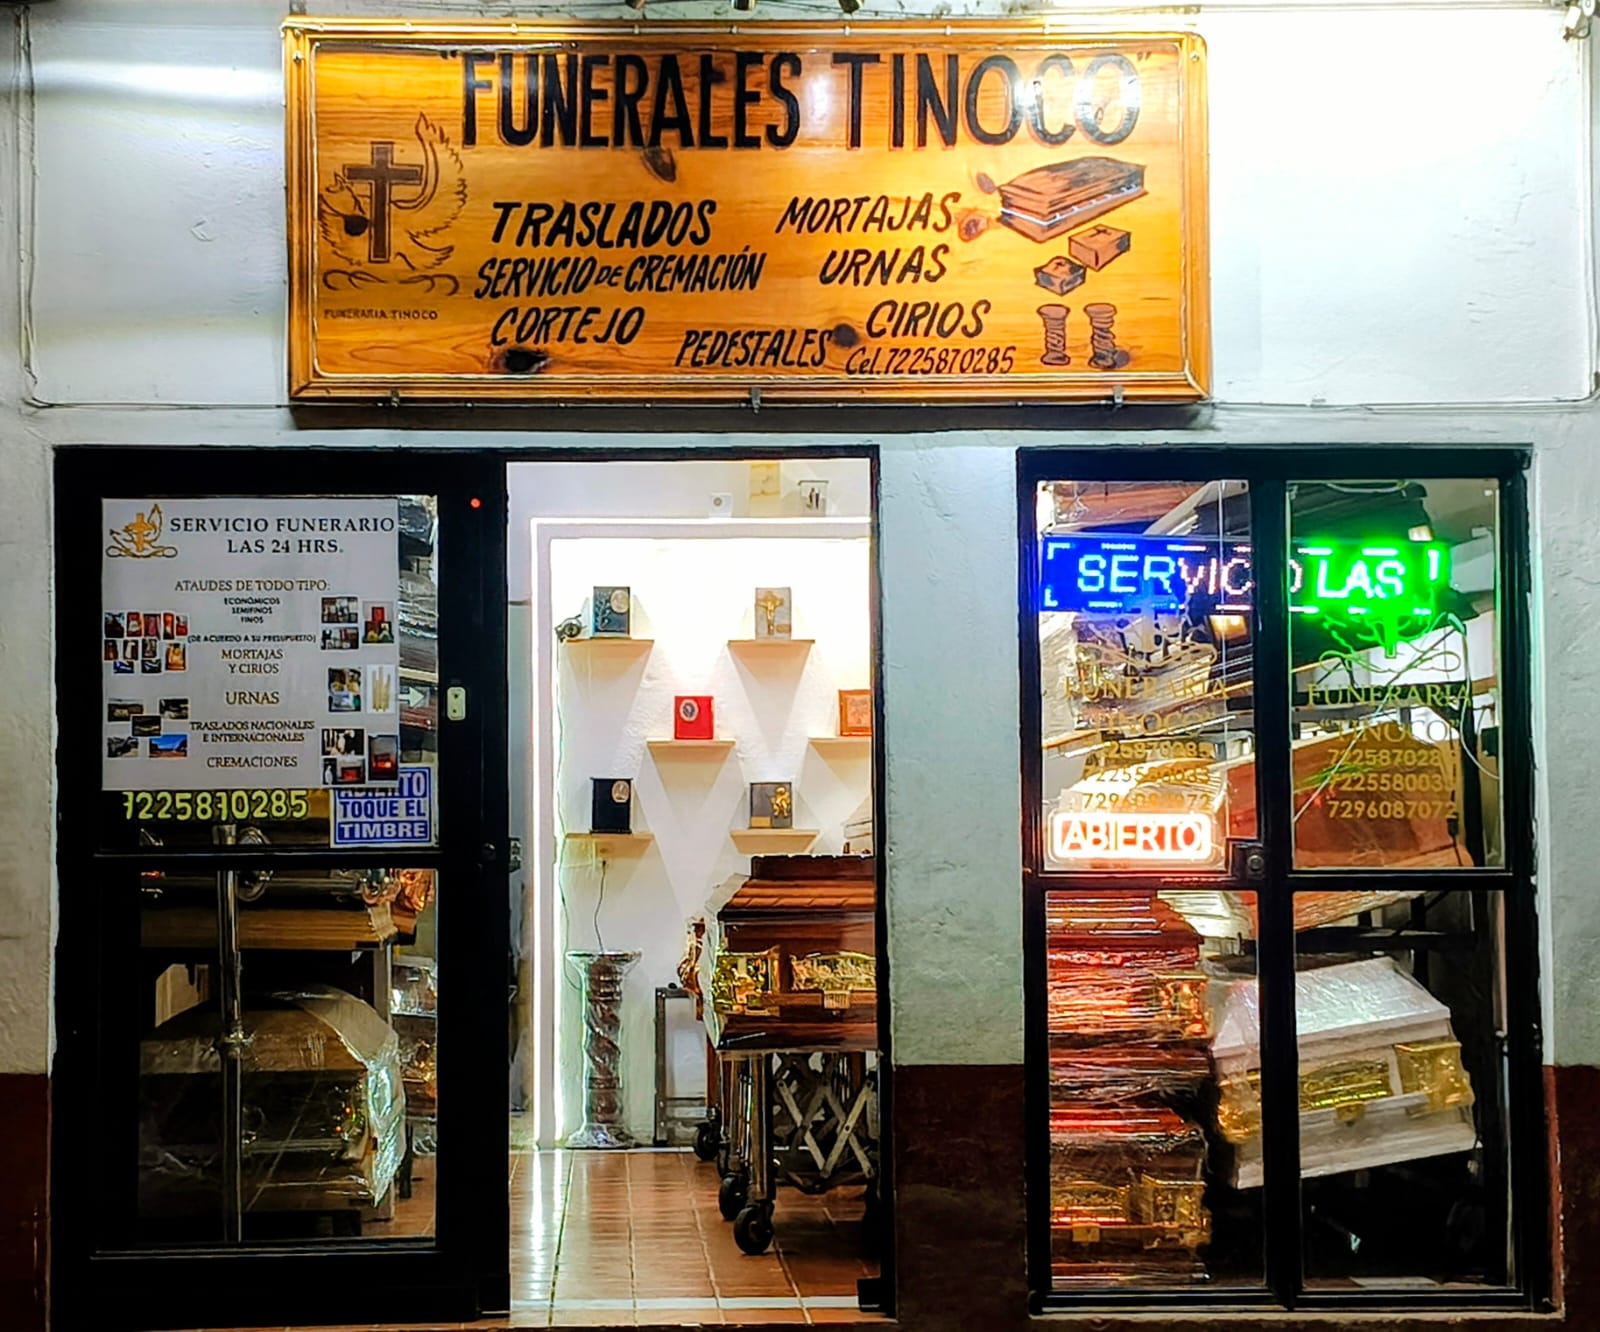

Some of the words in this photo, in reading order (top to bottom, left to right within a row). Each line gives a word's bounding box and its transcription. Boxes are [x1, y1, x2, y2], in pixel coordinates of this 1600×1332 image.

[775, 191, 961, 233] MORTAJAS
[491, 199, 717, 248] TRASLADOS
[474, 256, 597, 299] SERVICIO
[594, 265, 623, 287] DE
[623, 245, 767, 293] CREMACIÓN
[818, 244, 950, 285] URNAS
[324, 308, 388, 319] FUNERARIA
[391, 309, 438, 320] TINOCO
[866, 300, 991, 338] CIRIOS
[490, 306, 645, 346] CORTEJO
[674, 329, 832, 367] PEDESTALES
[170, 517, 269, 533] SERVICIO
[276, 516, 395, 533] FUNERARIO
[227, 539, 265, 554] LAS
[271, 538, 291, 553] 24
[299, 539, 344, 554] HRS.
[175, 580, 233, 592] ATAUDES
[236, 580, 252, 591] DE
[254, 580, 294, 592] TODO
[1316, 560, 1406, 599] LAS
[232, 607, 273, 615] SEMIFINOS
[240, 616, 264, 624] FINOS
[203, 635, 242, 643] ACUERDO
[243, 635, 250, 643] A
[251, 635, 262, 643] SU
[221, 648, 284, 661] MORTAJAS
[228, 664, 237, 674] Y
[239, 663, 280, 675] CIRIOS
[225, 691, 280, 705] URNAS
[1307, 683, 1472, 707] FUNERARIA
[190, 721, 249, 731] TRASLADOS
[251, 721, 315, 731] NACIONALES
[203, 733, 209, 742] E
[211, 733, 305, 743] INTERNACIONALES
[207, 756, 298, 768] CREMACIONES
[1327, 748, 1456, 767] 722587028
[123, 789, 309, 822] 7225870285
[339, 800, 399, 818] TOQUE
[405, 800, 426, 817] EL
[1327, 800, 1457, 819] 7296087072
[339, 822, 426, 838] TIMBRE
[1061, 818, 1204, 852] ABIERTO
